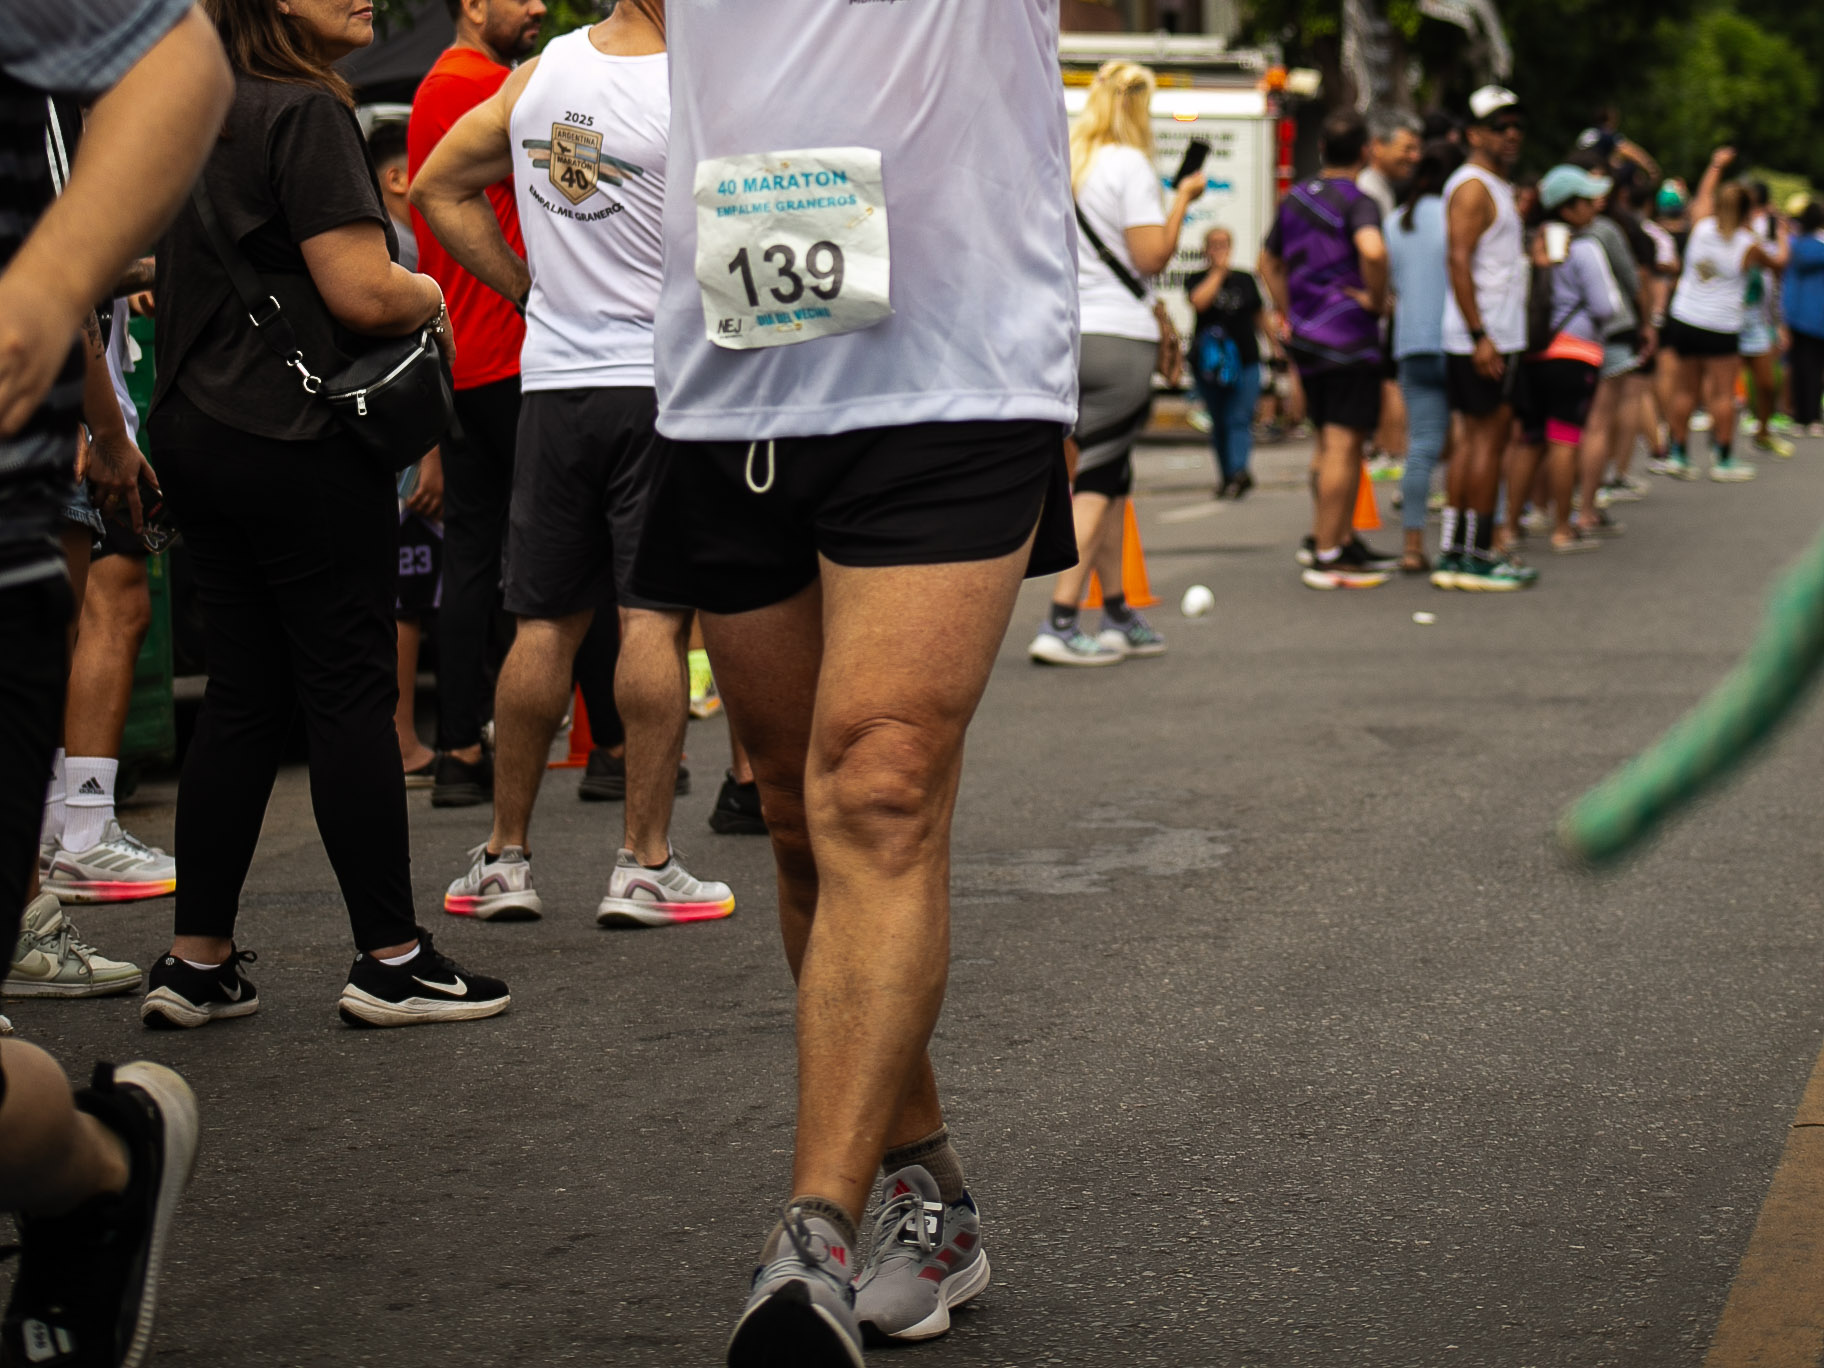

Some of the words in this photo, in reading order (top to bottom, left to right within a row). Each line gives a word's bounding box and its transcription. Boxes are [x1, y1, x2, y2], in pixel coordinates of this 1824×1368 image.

[564, 111, 594, 127] 2025
[557, 131, 596, 146] ARGENTINA
[561, 166, 589, 190] 40
[717, 180, 737, 196] 40
[743, 170, 848, 194] MARATON
[529, 184, 574, 219] EMPALME
[716, 200, 771, 218] EMPALME
[775, 194, 857, 213] GRANEROS
[728, 241, 844, 307] 139
